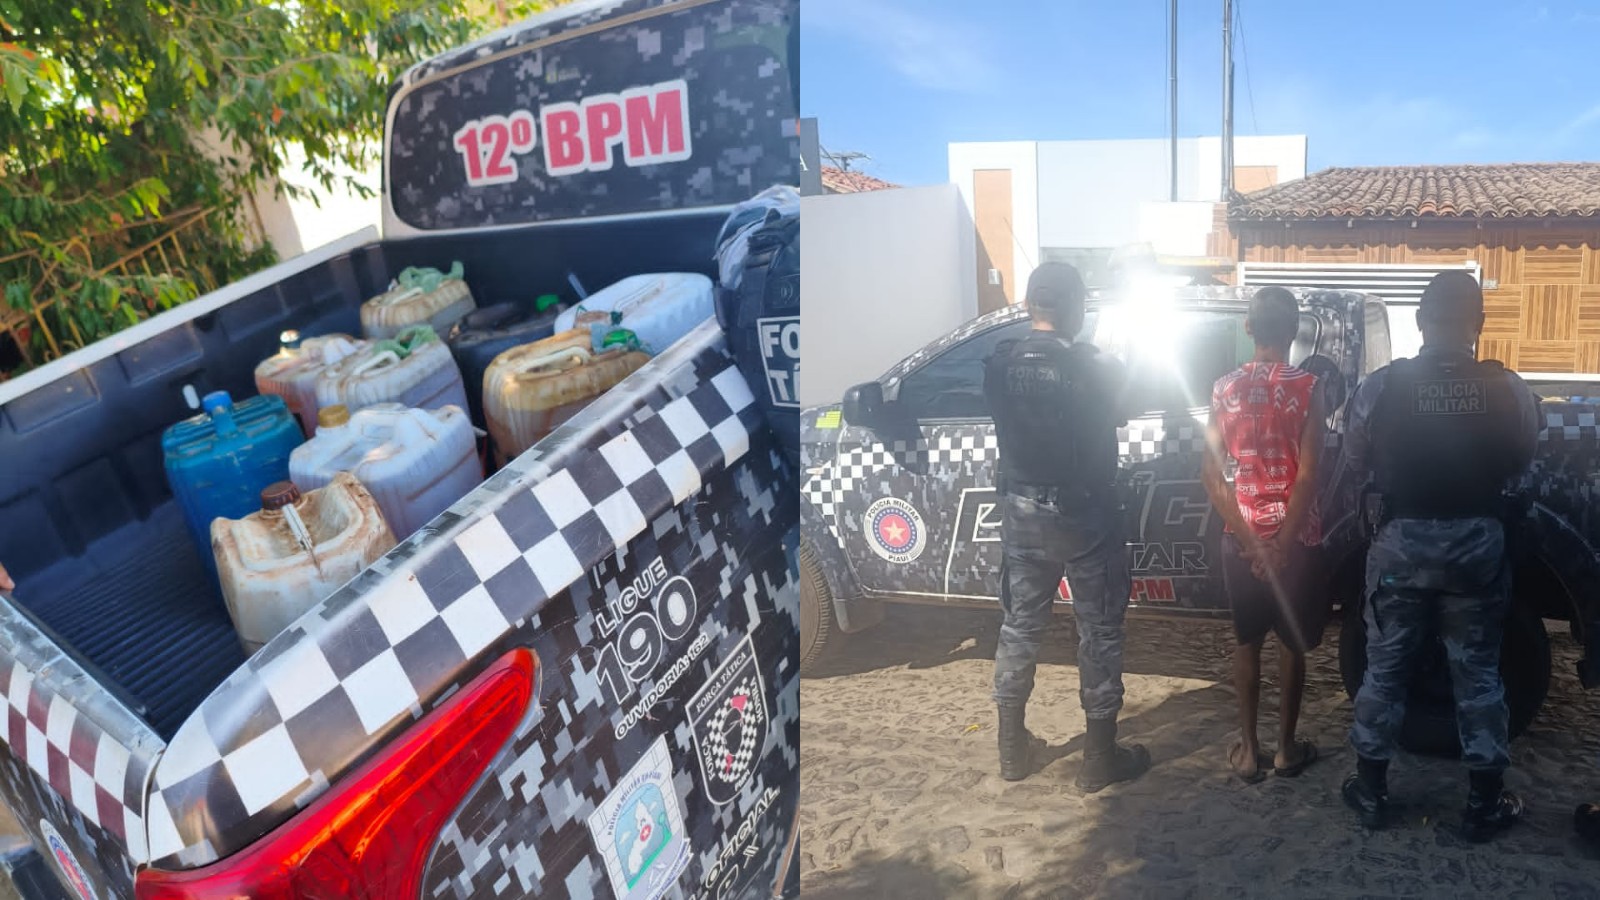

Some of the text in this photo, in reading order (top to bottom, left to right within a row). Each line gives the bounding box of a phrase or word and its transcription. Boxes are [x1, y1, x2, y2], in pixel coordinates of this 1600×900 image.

[543, 84, 688, 172] BPM
[1418, 398, 1480, 412] MILITAR
[893, 500, 920, 521] MILITAR
[596, 555, 668, 639] LIGUE
[595, 575, 697, 705] 190
[687, 632, 711, 664] 162
[695, 681, 721, 714] FORÇA
[706, 785, 780, 888] OFICIAL
